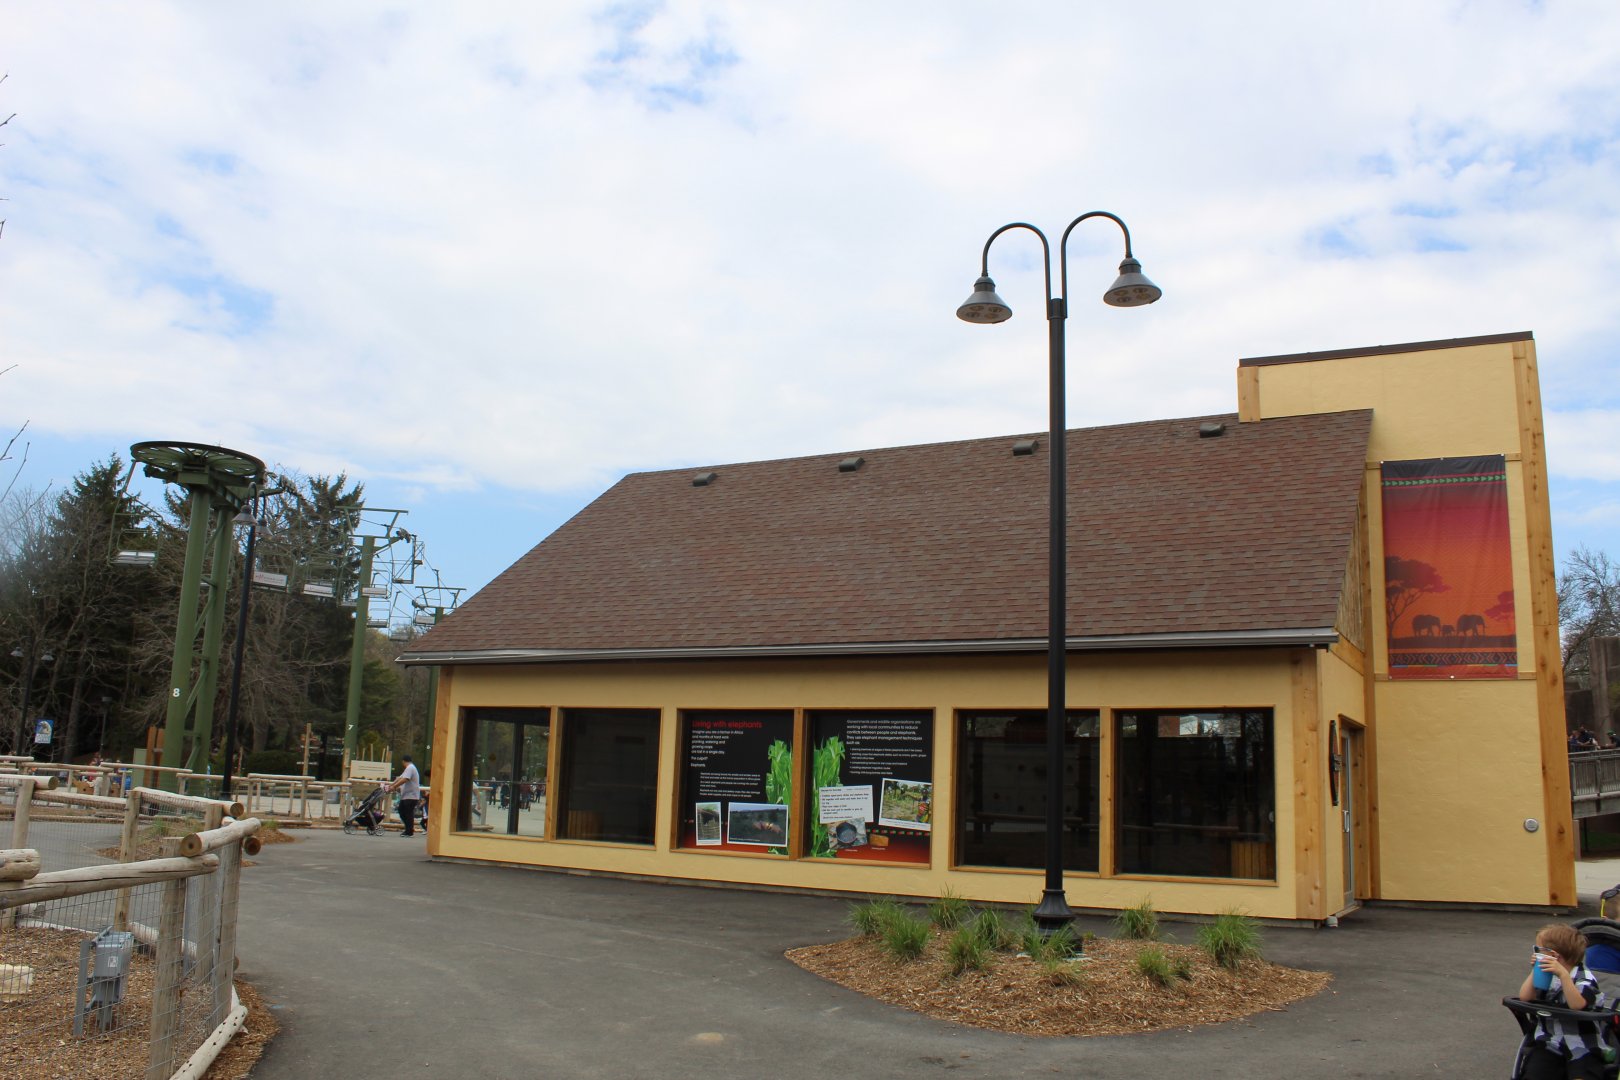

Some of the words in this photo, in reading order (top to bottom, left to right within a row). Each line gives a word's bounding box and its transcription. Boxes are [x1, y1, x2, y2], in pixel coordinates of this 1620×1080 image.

[173, 687, 180, 697] 8
[692, 720, 711, 729] Living
[713, 720, 726, 728] with
[728, 721, 762, 729] elephants
